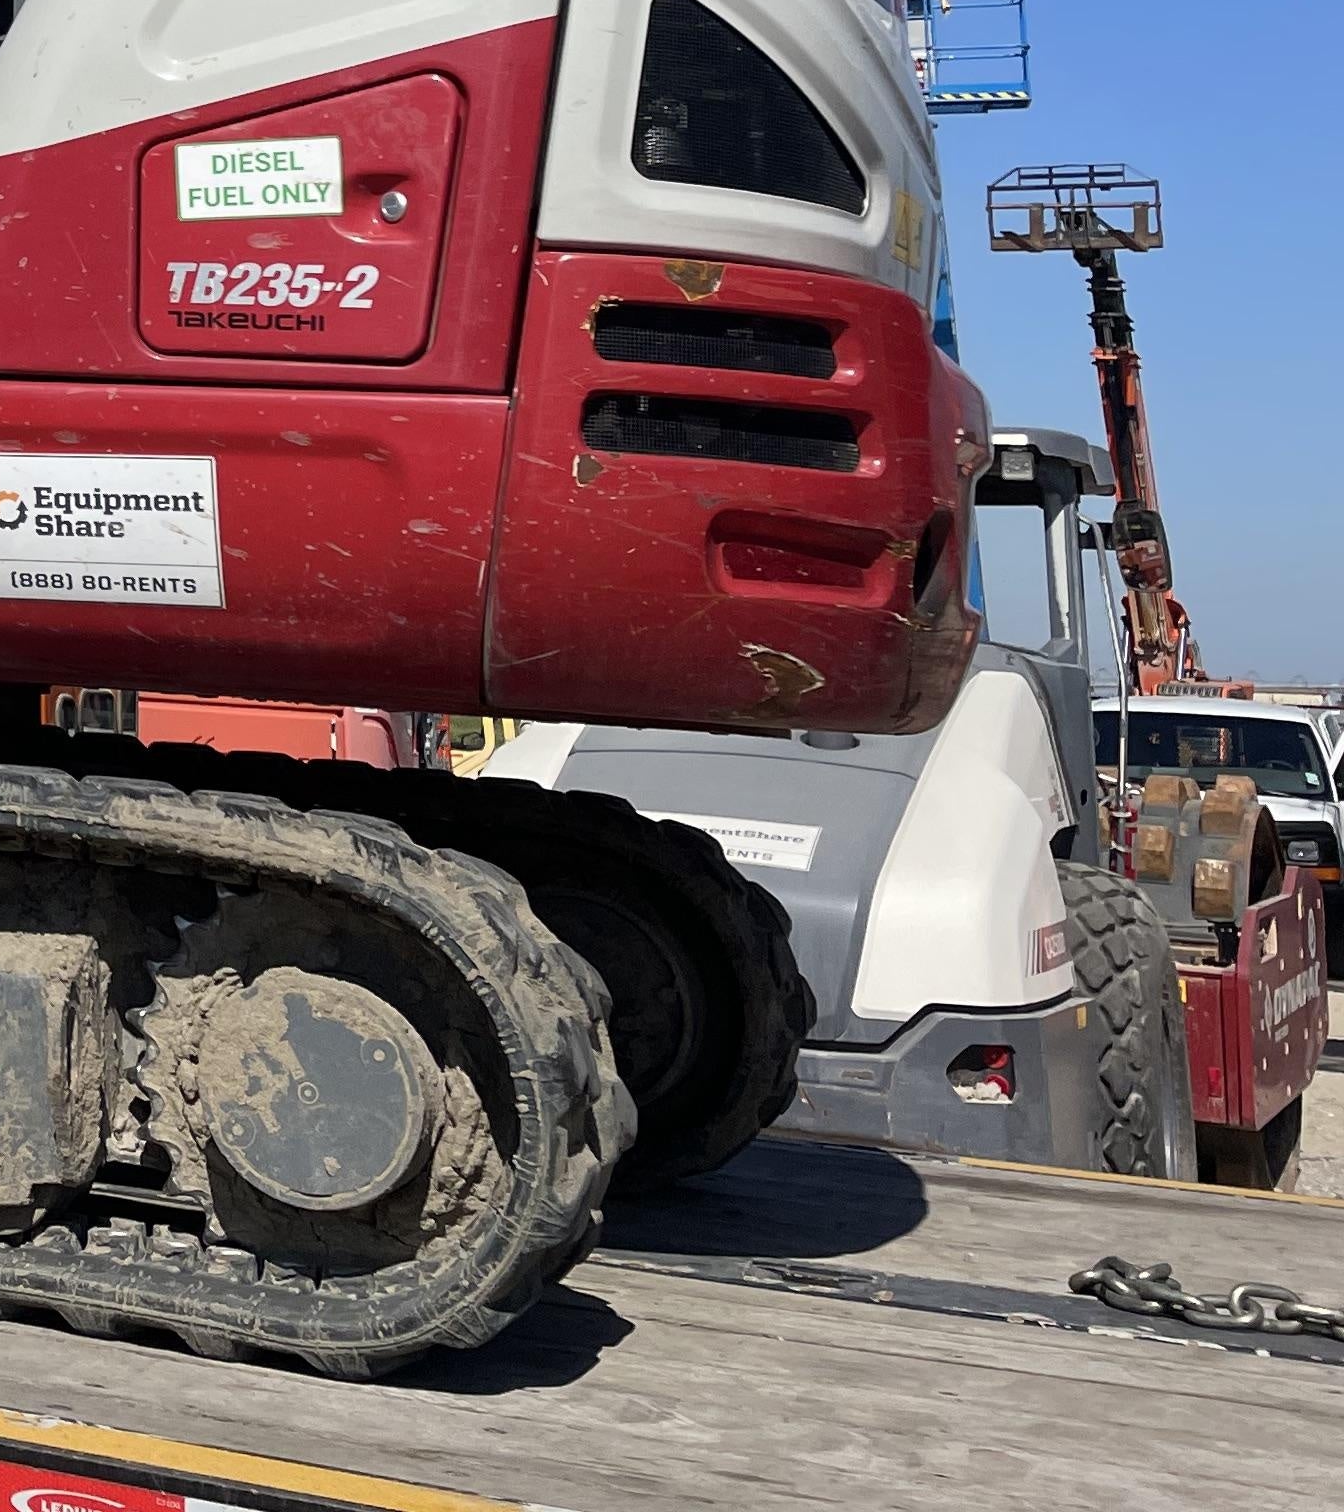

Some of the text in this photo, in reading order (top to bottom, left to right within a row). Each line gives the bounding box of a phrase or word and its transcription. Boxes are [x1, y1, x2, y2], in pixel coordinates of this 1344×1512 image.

[212, 151, 304, 175] DIESEL
[189, 182, 331, 208] FUEL ONLY
[166, 262, 380, 309] TB235-2
[33, 486, 205, 516] Equipment
[36, 515, 125, 538] Share
[10, 571, 197, 594] (888) 80-RENTS
